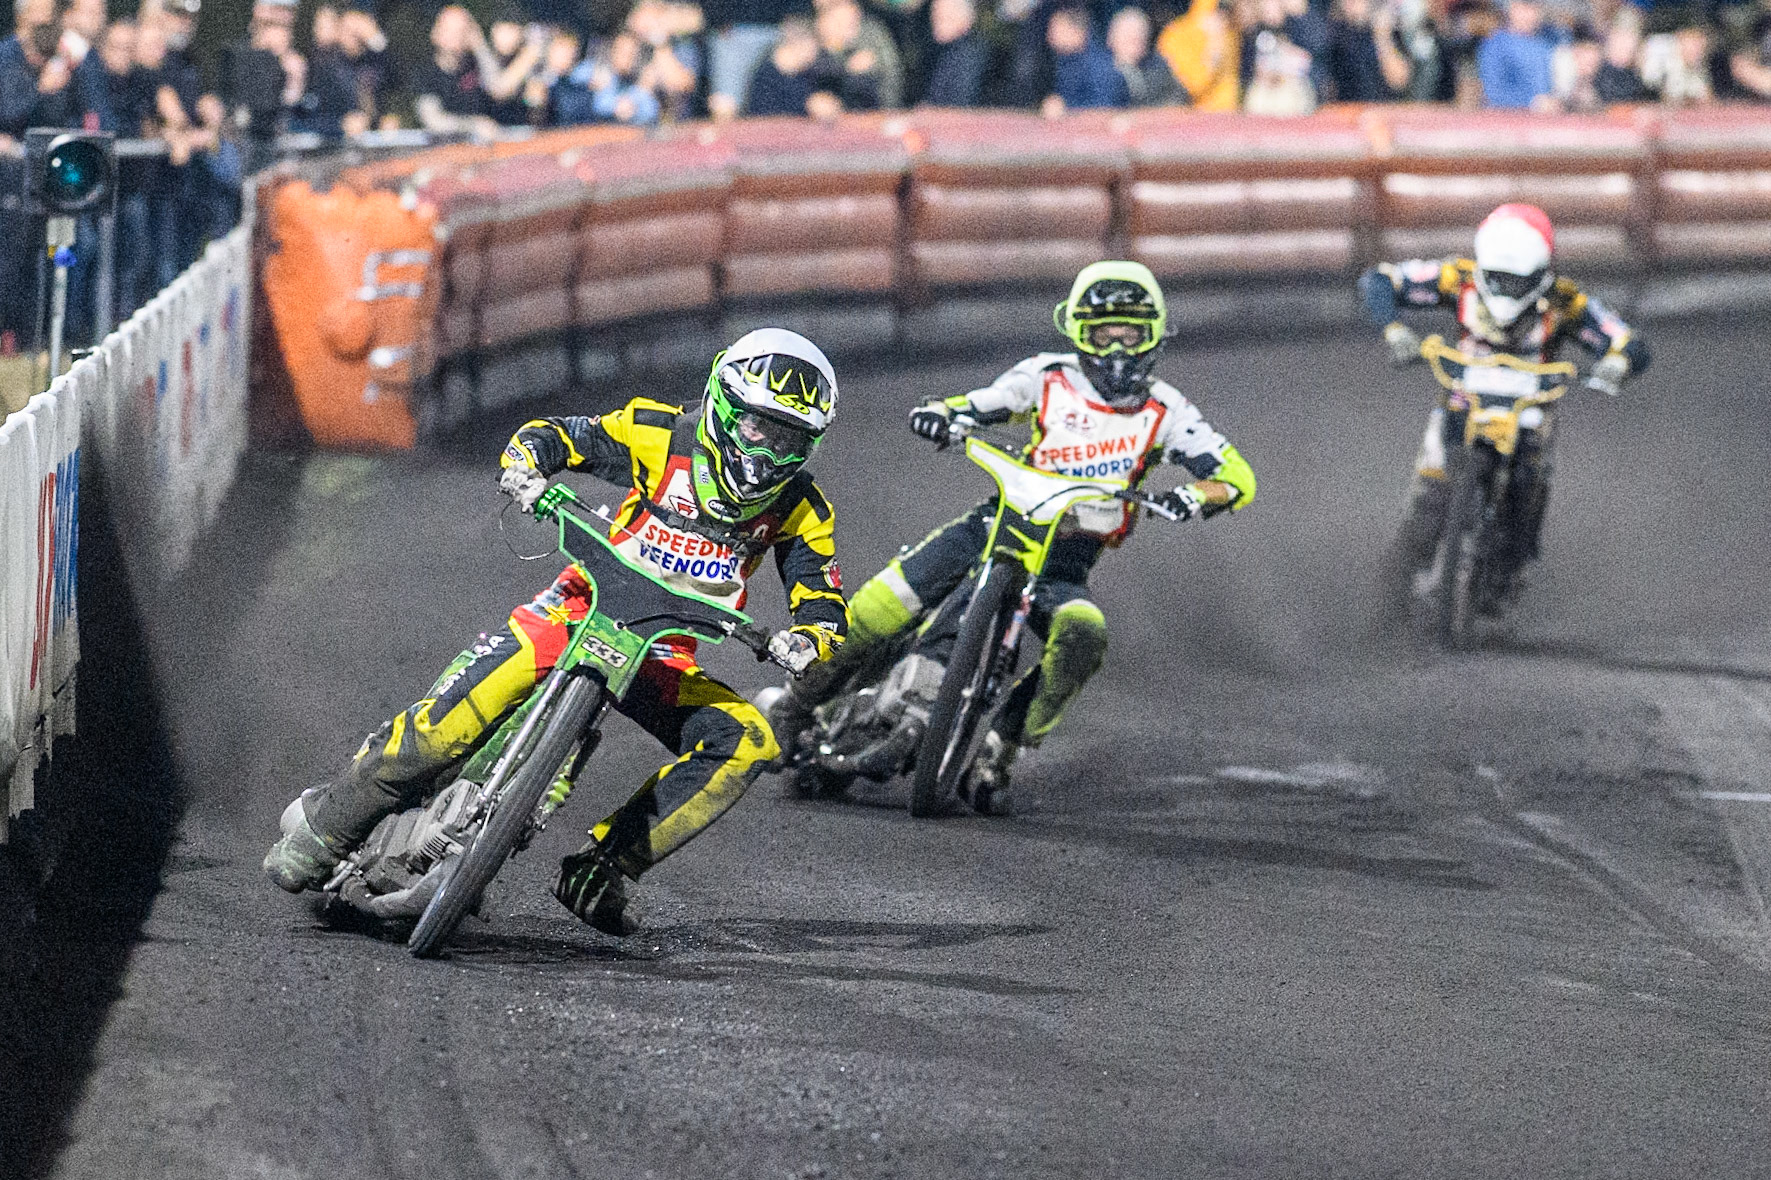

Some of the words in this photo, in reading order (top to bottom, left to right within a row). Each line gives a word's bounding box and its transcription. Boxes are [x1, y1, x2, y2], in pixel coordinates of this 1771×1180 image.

[1039, 435, 1137, 465] SPEEDWAY
[645, 524, 734, 560] SPEEDW
[582, 635, 629, 669] 333
